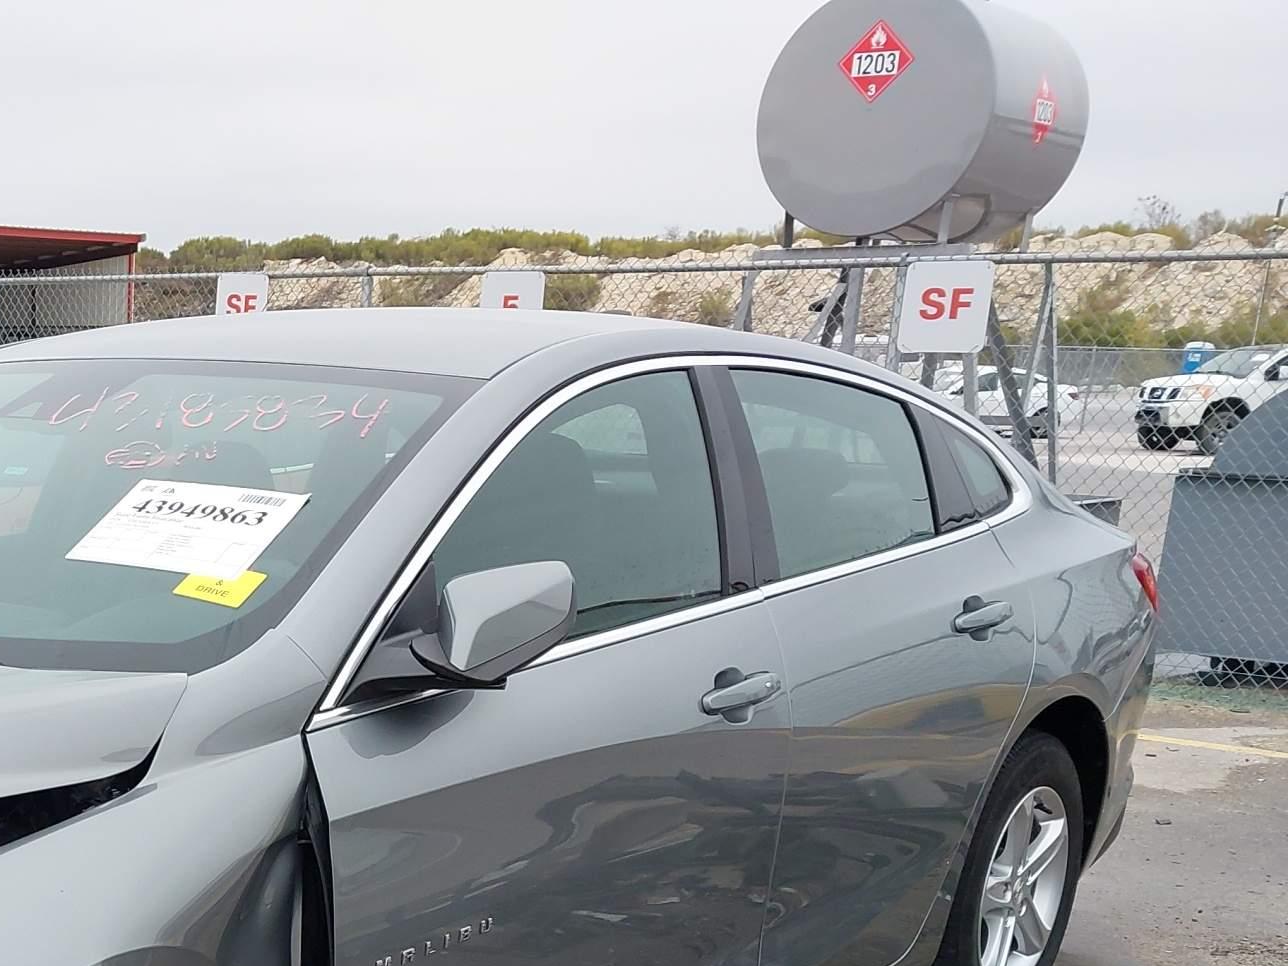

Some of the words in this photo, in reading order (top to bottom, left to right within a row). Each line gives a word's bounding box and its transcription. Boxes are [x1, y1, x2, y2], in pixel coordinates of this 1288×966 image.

[856, 52, 897, 75] 1203
[866, 83, 877, 96] 3
[226, 294, 258, 314] SF
[919, 287, 974, 320] SF
[132, 498, 269, 527] 43949863
[195, 584, 230, 598] DRIVE
